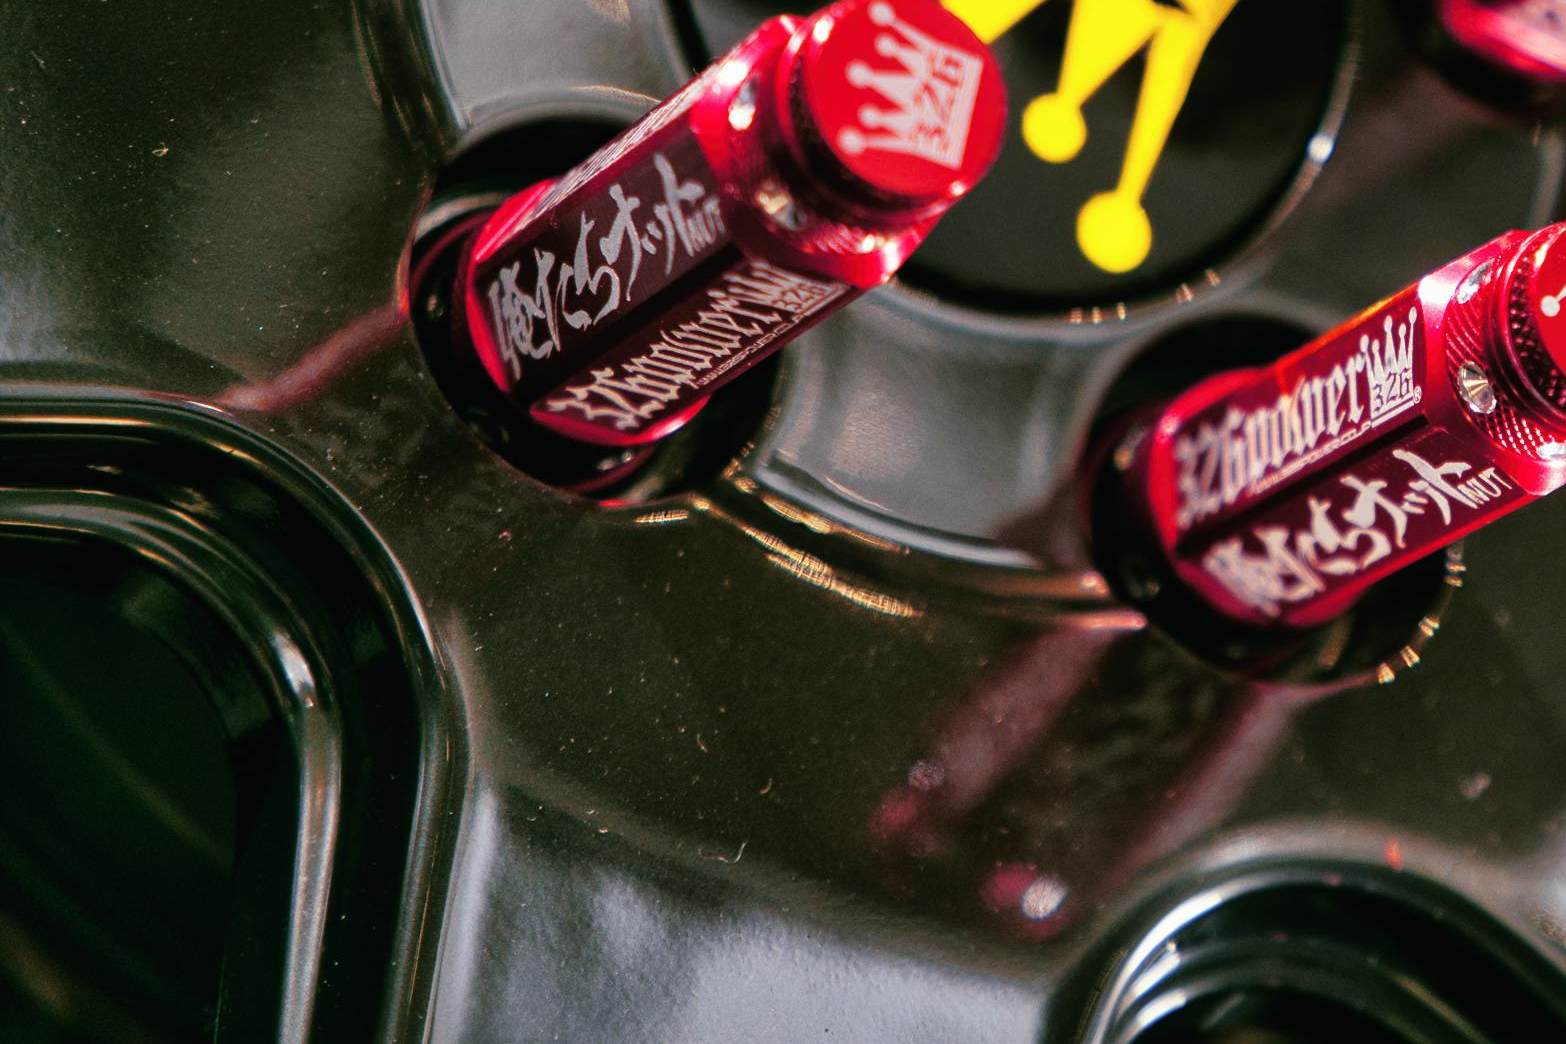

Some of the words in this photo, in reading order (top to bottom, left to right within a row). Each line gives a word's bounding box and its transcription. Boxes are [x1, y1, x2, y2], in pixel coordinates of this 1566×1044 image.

[912, 51, 963, 152] 326
[1372, 368, 1412, 413] 326
[1461, 466, 1513, 508] NUT
